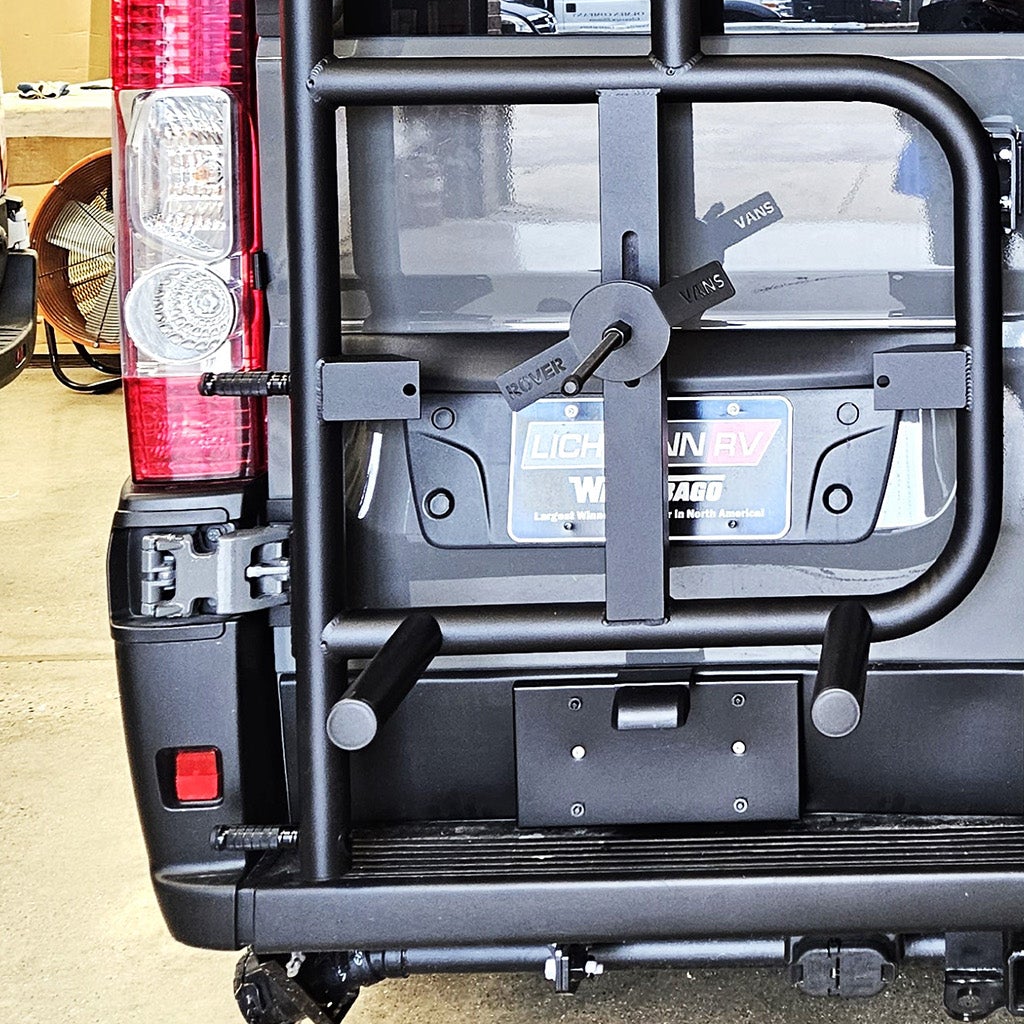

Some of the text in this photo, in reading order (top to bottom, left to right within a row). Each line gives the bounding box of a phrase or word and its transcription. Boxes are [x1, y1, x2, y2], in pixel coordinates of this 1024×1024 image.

[733, 201, 775, 229] VANS
[505, 274, 725, 400] ROVER VANS
[531, 431, 764, 459] LICHNN RV
[568, 474, 726, 504] WIAGO
[686, 509, 716, 519] North
